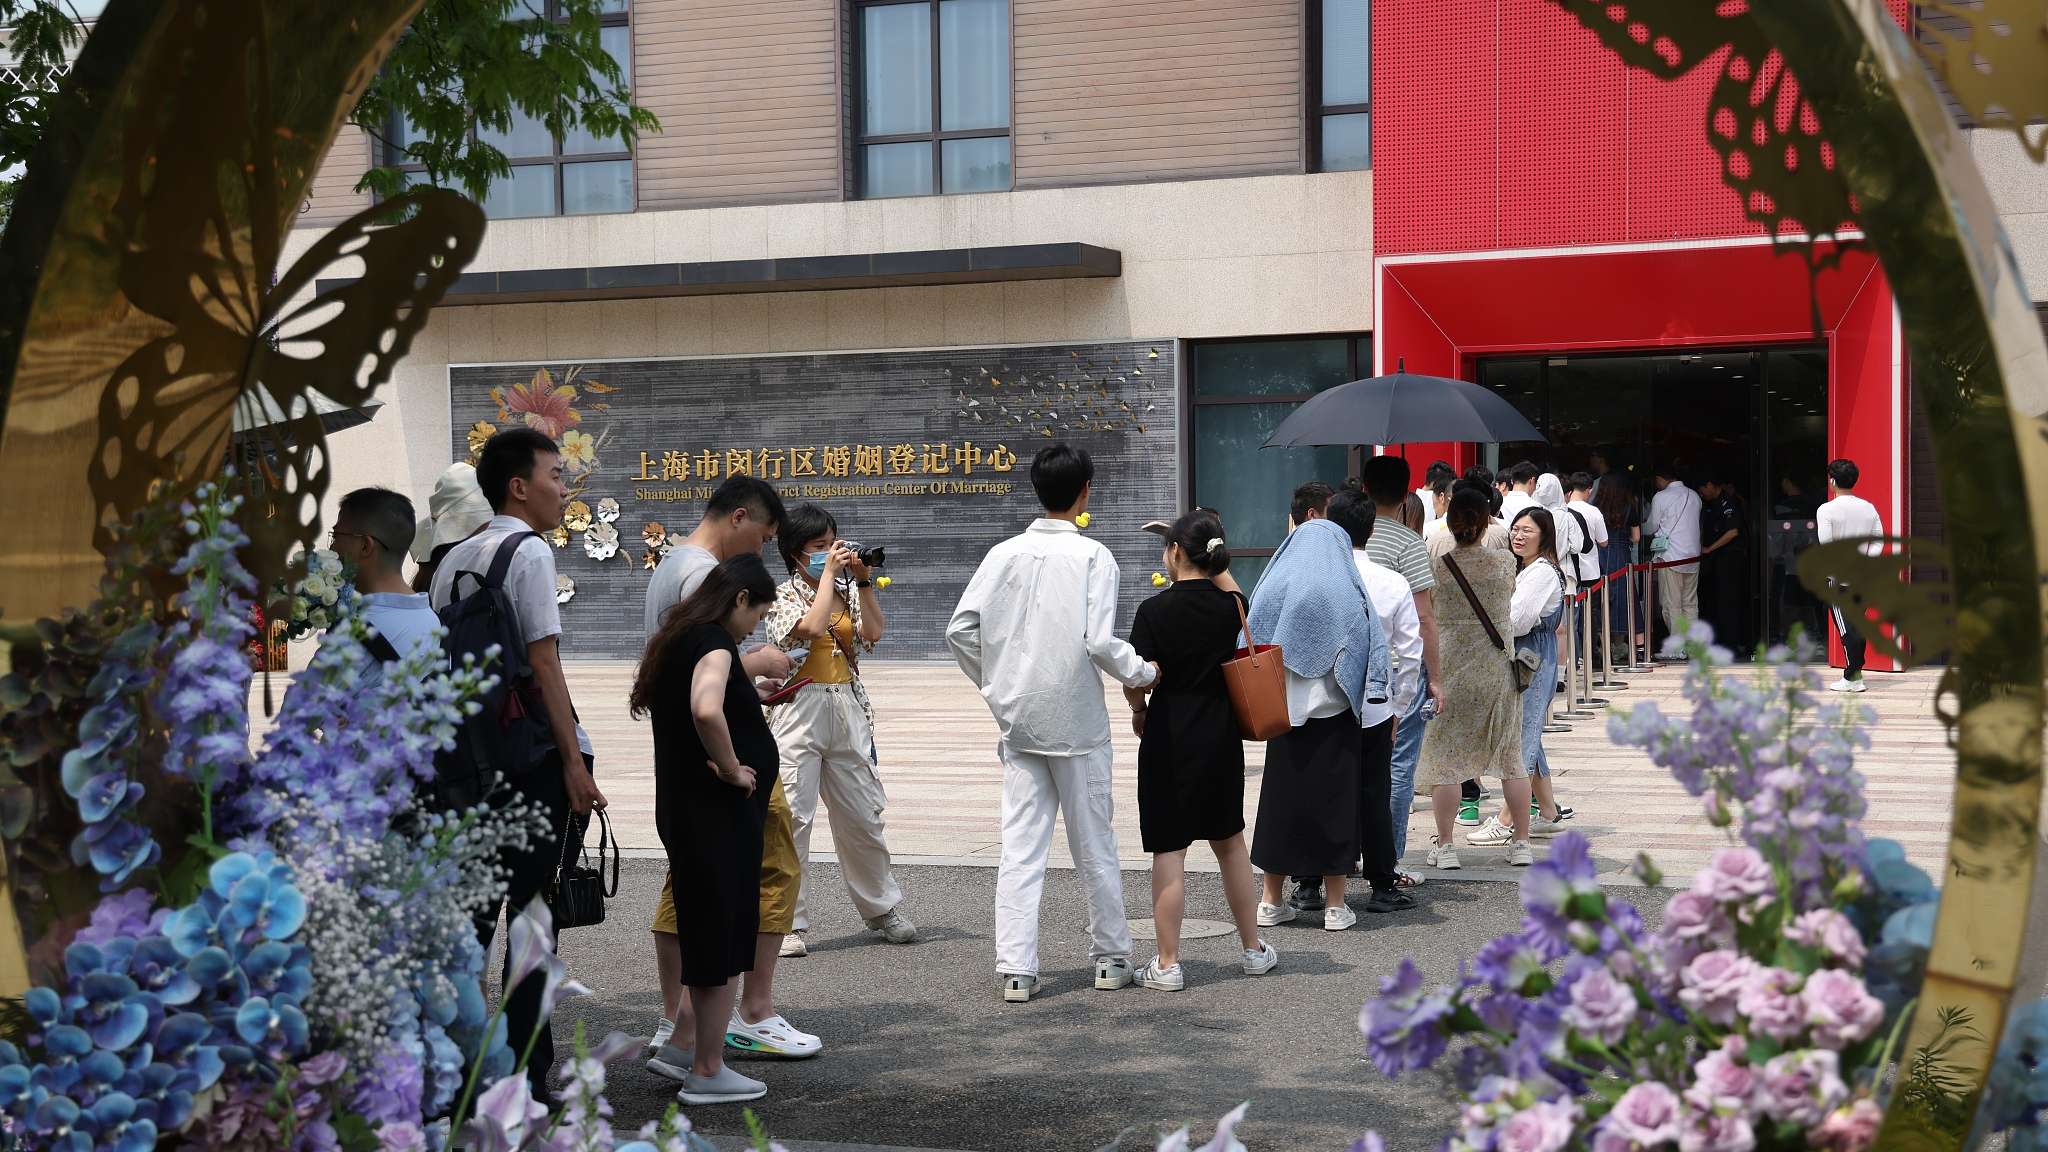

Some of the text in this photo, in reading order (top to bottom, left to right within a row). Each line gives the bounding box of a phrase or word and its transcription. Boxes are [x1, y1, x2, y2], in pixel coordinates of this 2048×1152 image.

[630, 441, 1017, 481] 上海市闵行区婚姻登记中心
[635, 486, 692, 502] Shanghai
[803, 482, 880, 499] Registration
[883, 482, 927, 495] Center
[930, 481, 949, 495] Of
[951, 480, 1012, 496] Marriage
